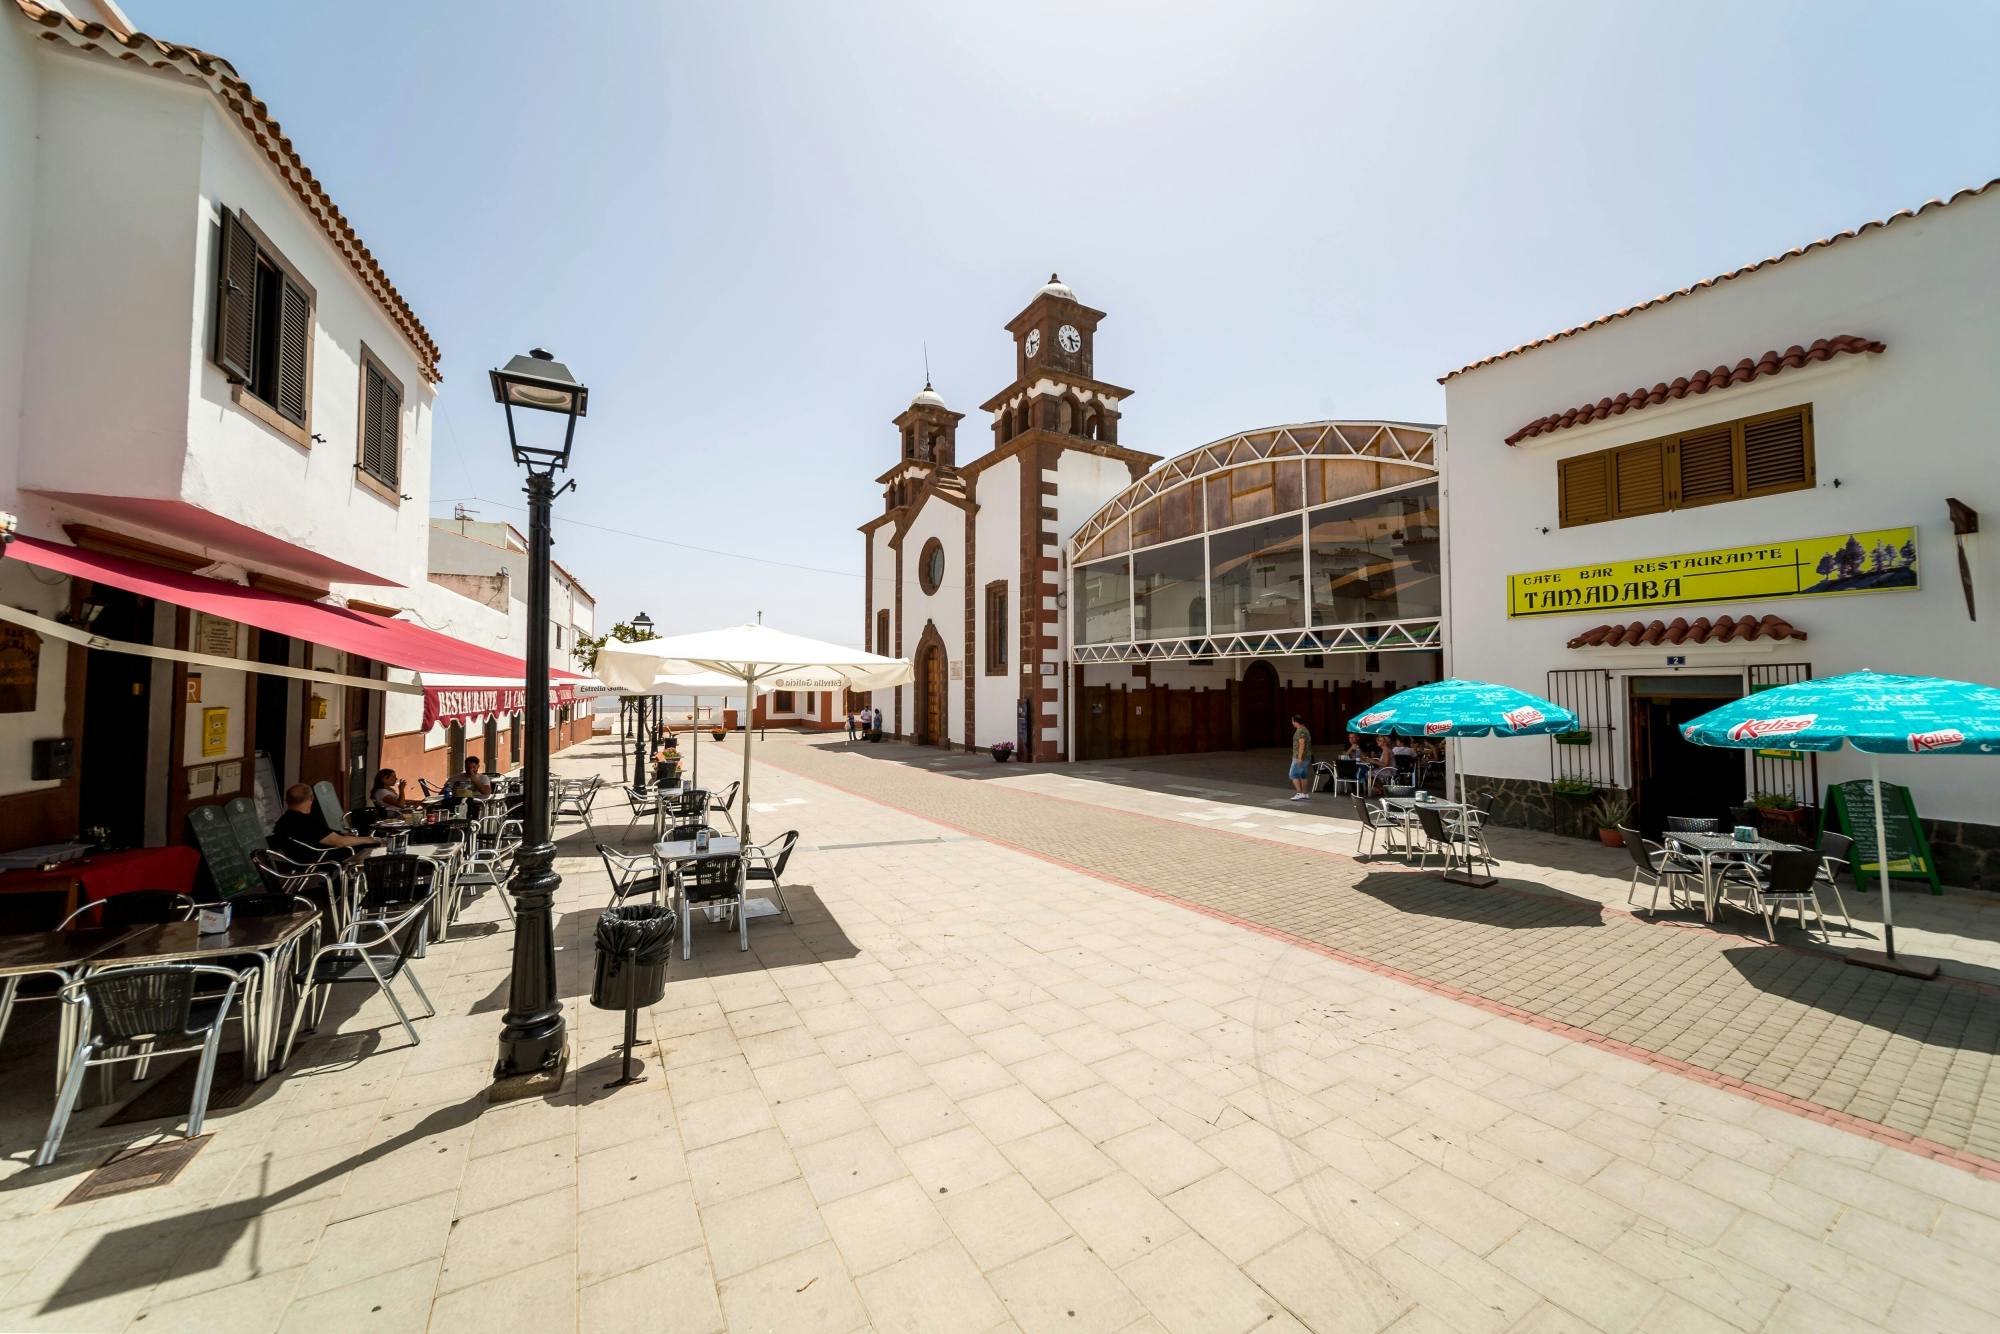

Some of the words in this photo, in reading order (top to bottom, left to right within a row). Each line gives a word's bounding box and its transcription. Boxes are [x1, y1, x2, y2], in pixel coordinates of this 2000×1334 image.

[1523, 573, 1561, 586] CAFE
[1580, 568, 1613, 579] BAR
[1634, 548, 1782, 574] RESTAURANTE
[1524, 578, 1681, 609] TAMADABA
[1673, 657, 1679, 665] 2
[437, 690, 497, 716] RESTAURANTE
[1503, 710, 1543, 731] Kalise
[1734, 719, 1812, 740] Kalise
[1911, 732, 1963, 751] Kalise
